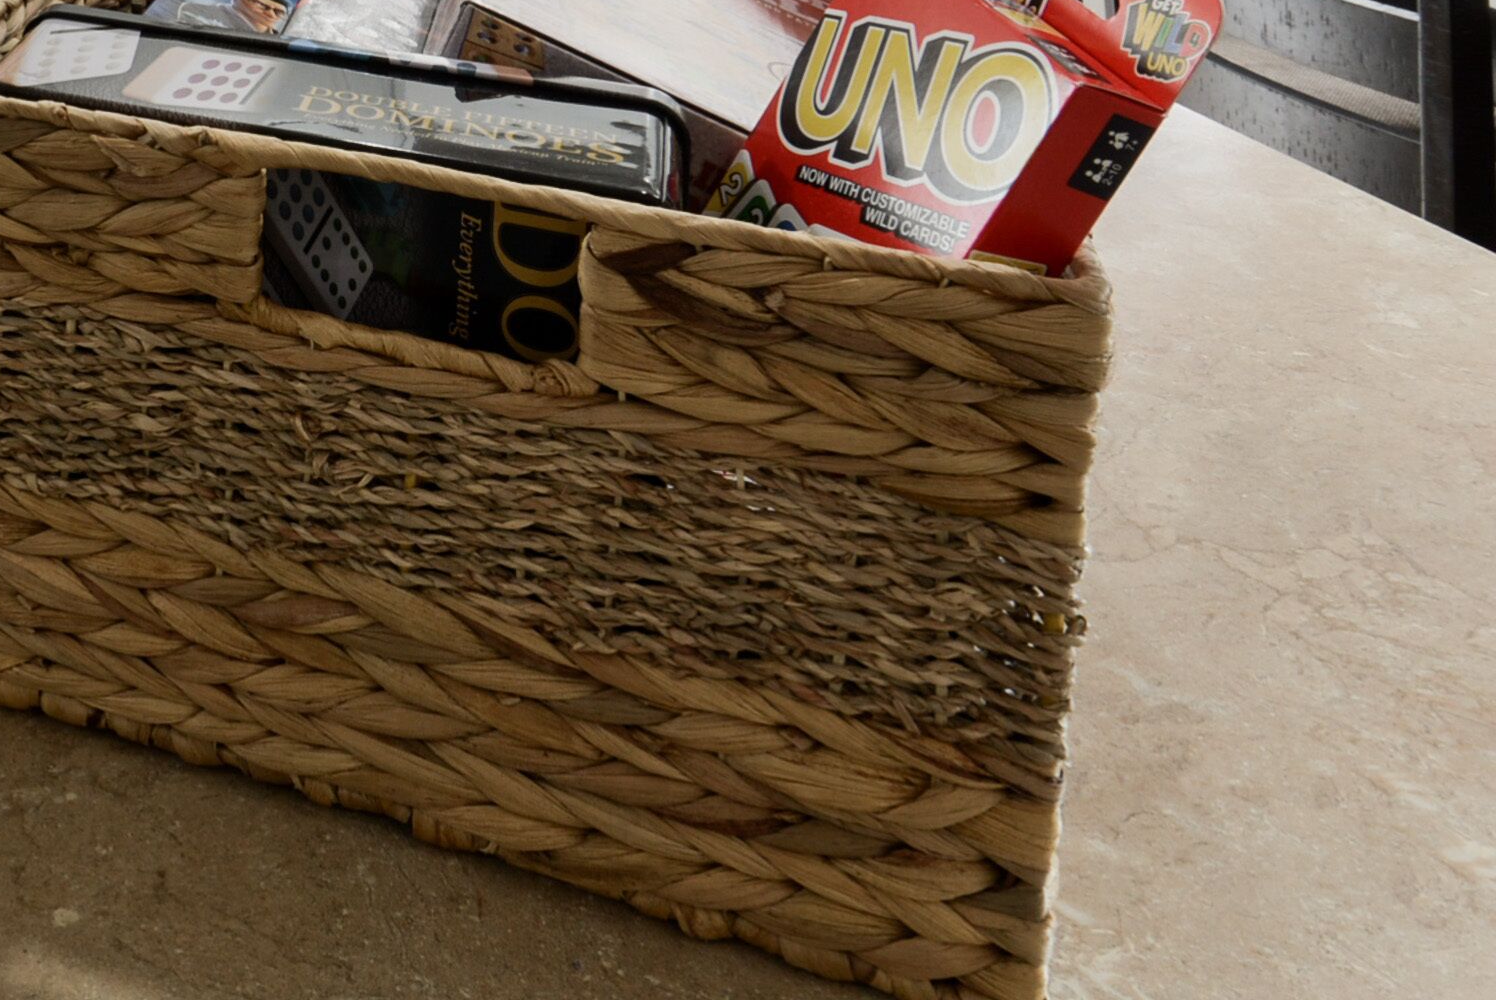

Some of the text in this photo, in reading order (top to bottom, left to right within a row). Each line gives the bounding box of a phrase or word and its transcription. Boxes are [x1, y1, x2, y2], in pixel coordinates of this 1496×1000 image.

[1147, 51, 1185, 76] UNO
[295, 94, 625, 165] DOMINOES
[310, 85, 617, 144] DOUBLE FIFTEEN
[779, 10, 1057, 202] UNO
[798, 165, 971, 239] NOW WITH CUSTOMIZABLE
[864, 206, 954, 253] WILD CARDS!
[448, 210, 483, 343] Everything
